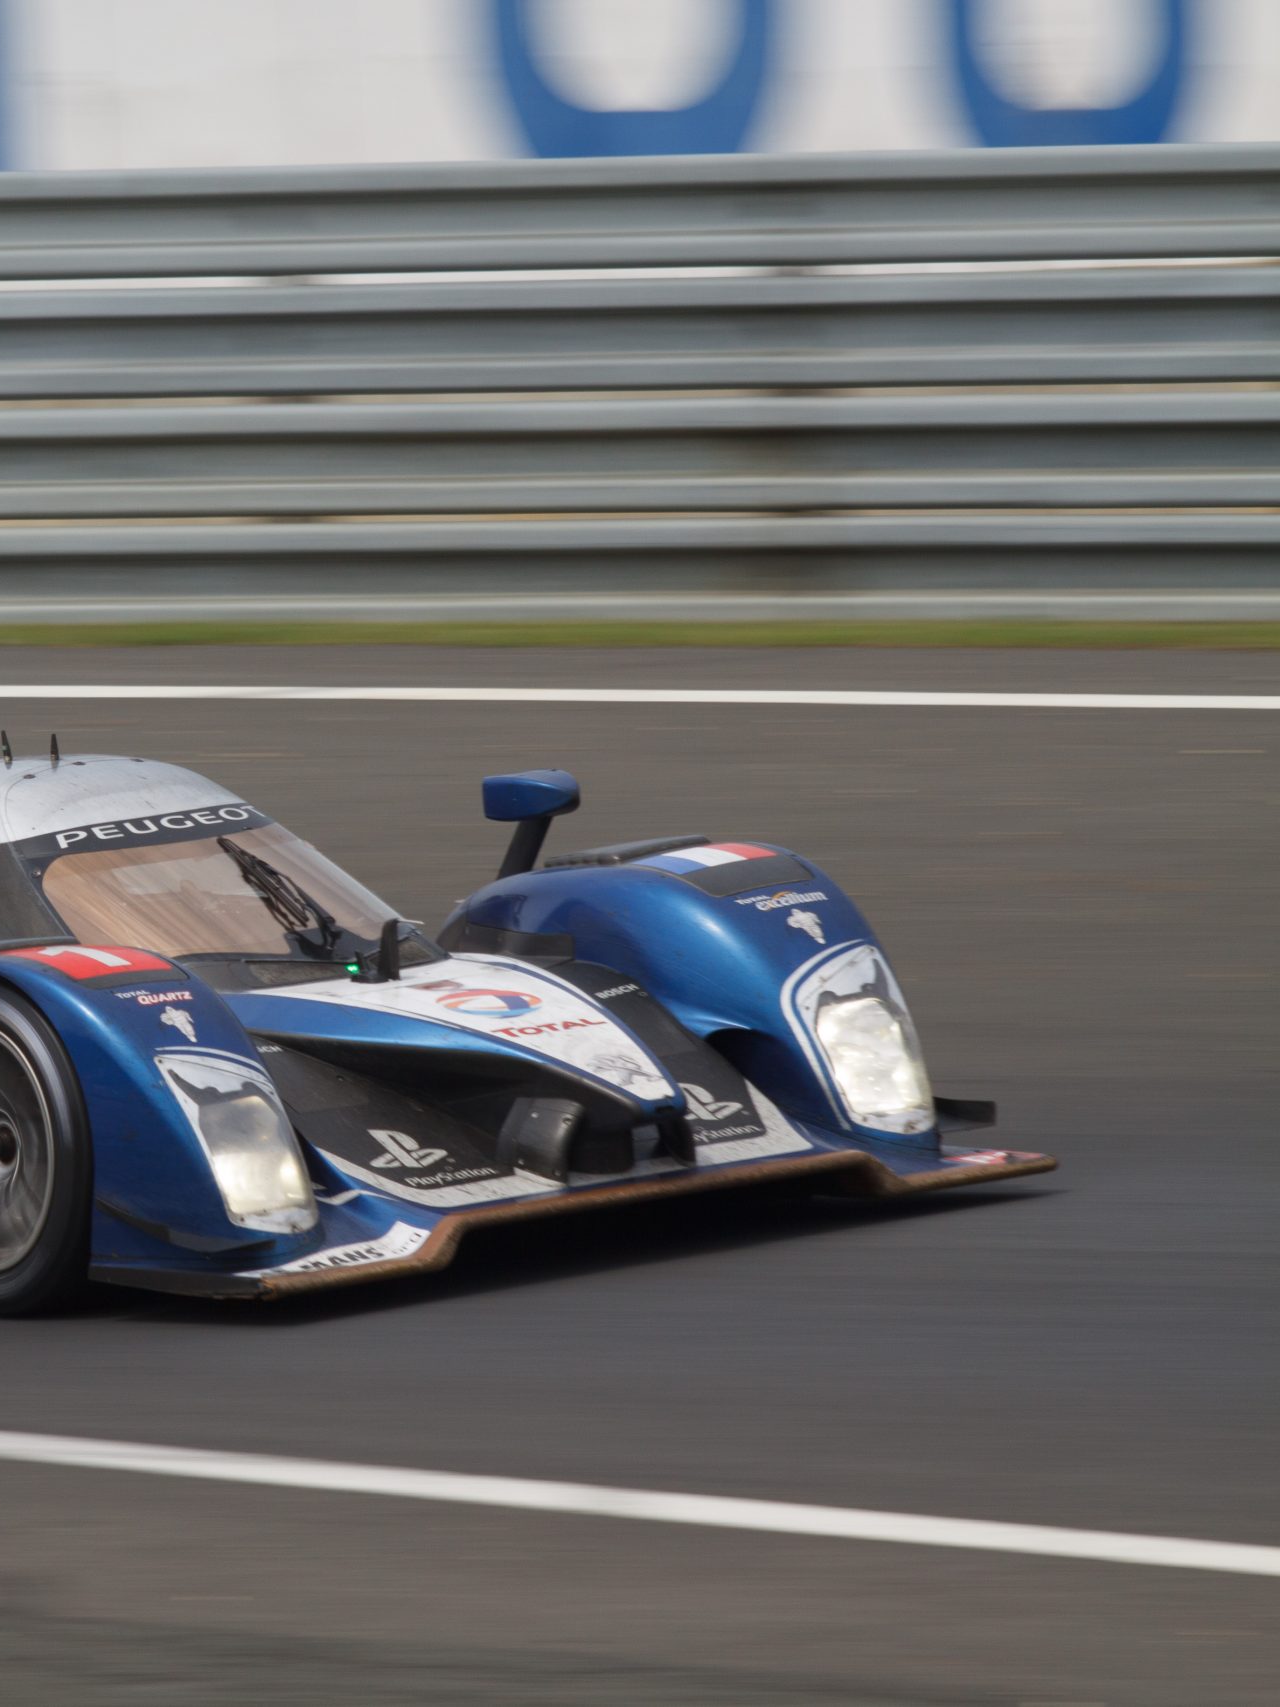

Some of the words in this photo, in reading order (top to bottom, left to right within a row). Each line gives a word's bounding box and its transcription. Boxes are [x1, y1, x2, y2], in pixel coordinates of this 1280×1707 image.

[55, 805, 267, 849] PEUGEOT
[113, 989, 151, 999] TOTAL
[136, 990, 193, 1005] QUARTZ
[595, 983, 639, 999] BOSCH
[490, 1018, 607, 1038] TOTAL
[404, 1166, 496, 1188] PlayStation
